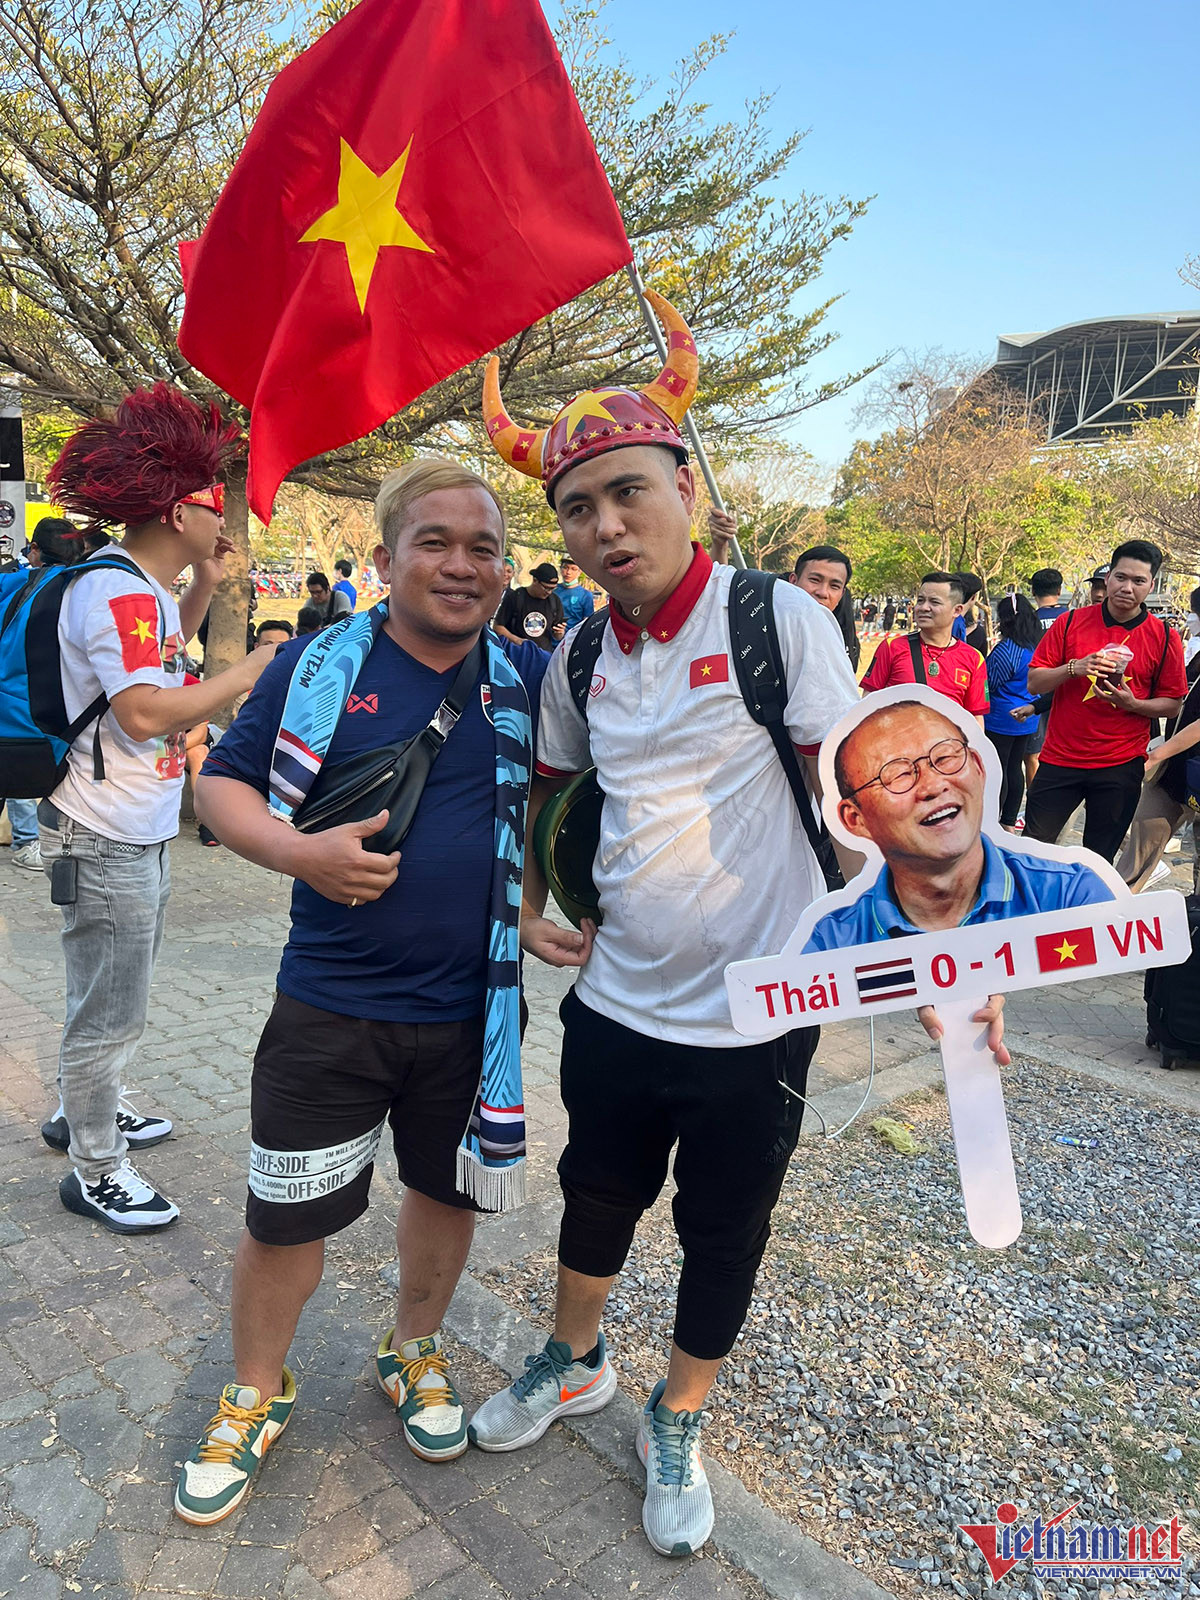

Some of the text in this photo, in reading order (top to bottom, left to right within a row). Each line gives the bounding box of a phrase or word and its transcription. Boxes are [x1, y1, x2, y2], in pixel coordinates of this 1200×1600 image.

[299, 653, 325, 688] TEAM
[755, 972, 840, 1018] Thái
[930, 953, 958, 989] 0
[994, 942, 1016, 977] 1
[1106, 916, 1164, 958] VN
[256, 1151, 310, 1174] OFF-SIDE
[287, 1169, 347, 1200] OFF-SIDE
